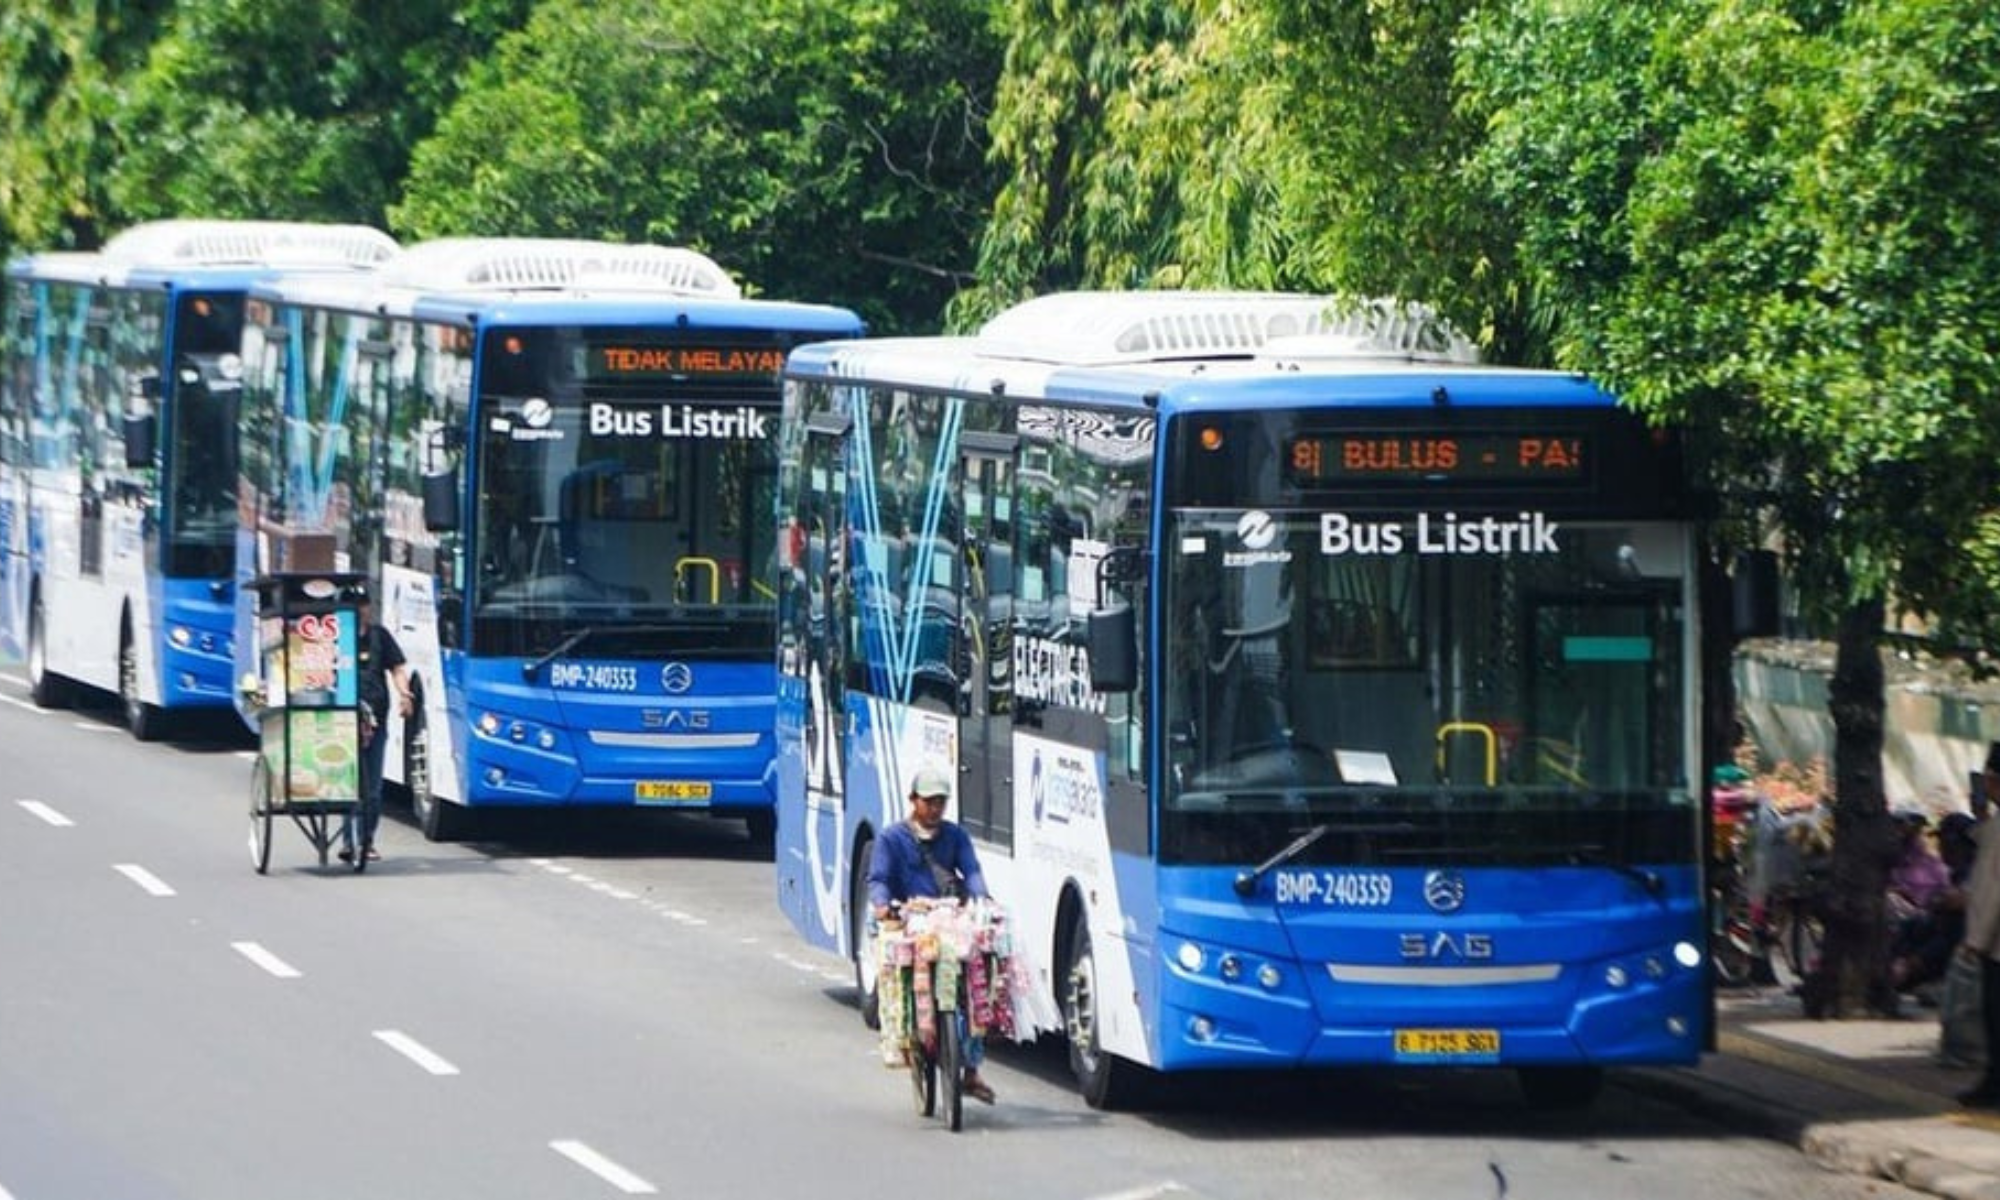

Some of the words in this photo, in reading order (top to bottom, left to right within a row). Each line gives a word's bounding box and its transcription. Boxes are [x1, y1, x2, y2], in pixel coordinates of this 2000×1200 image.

[604, 349, 672, 371] TIDAK
[590, 403, 652, 435] Bus
[662, 404, 766, 439] Listrik
[1343, 439, 1458, 469] BULUS
[1320, 512, 1403, 555] Bus
[1417, 513, 1560, 554] Listrik
[643, 709, 709, 728] SAG
[1276, 871, 1392, 905] BMP-240359
[1400, 931, 1492, 958] SAG
